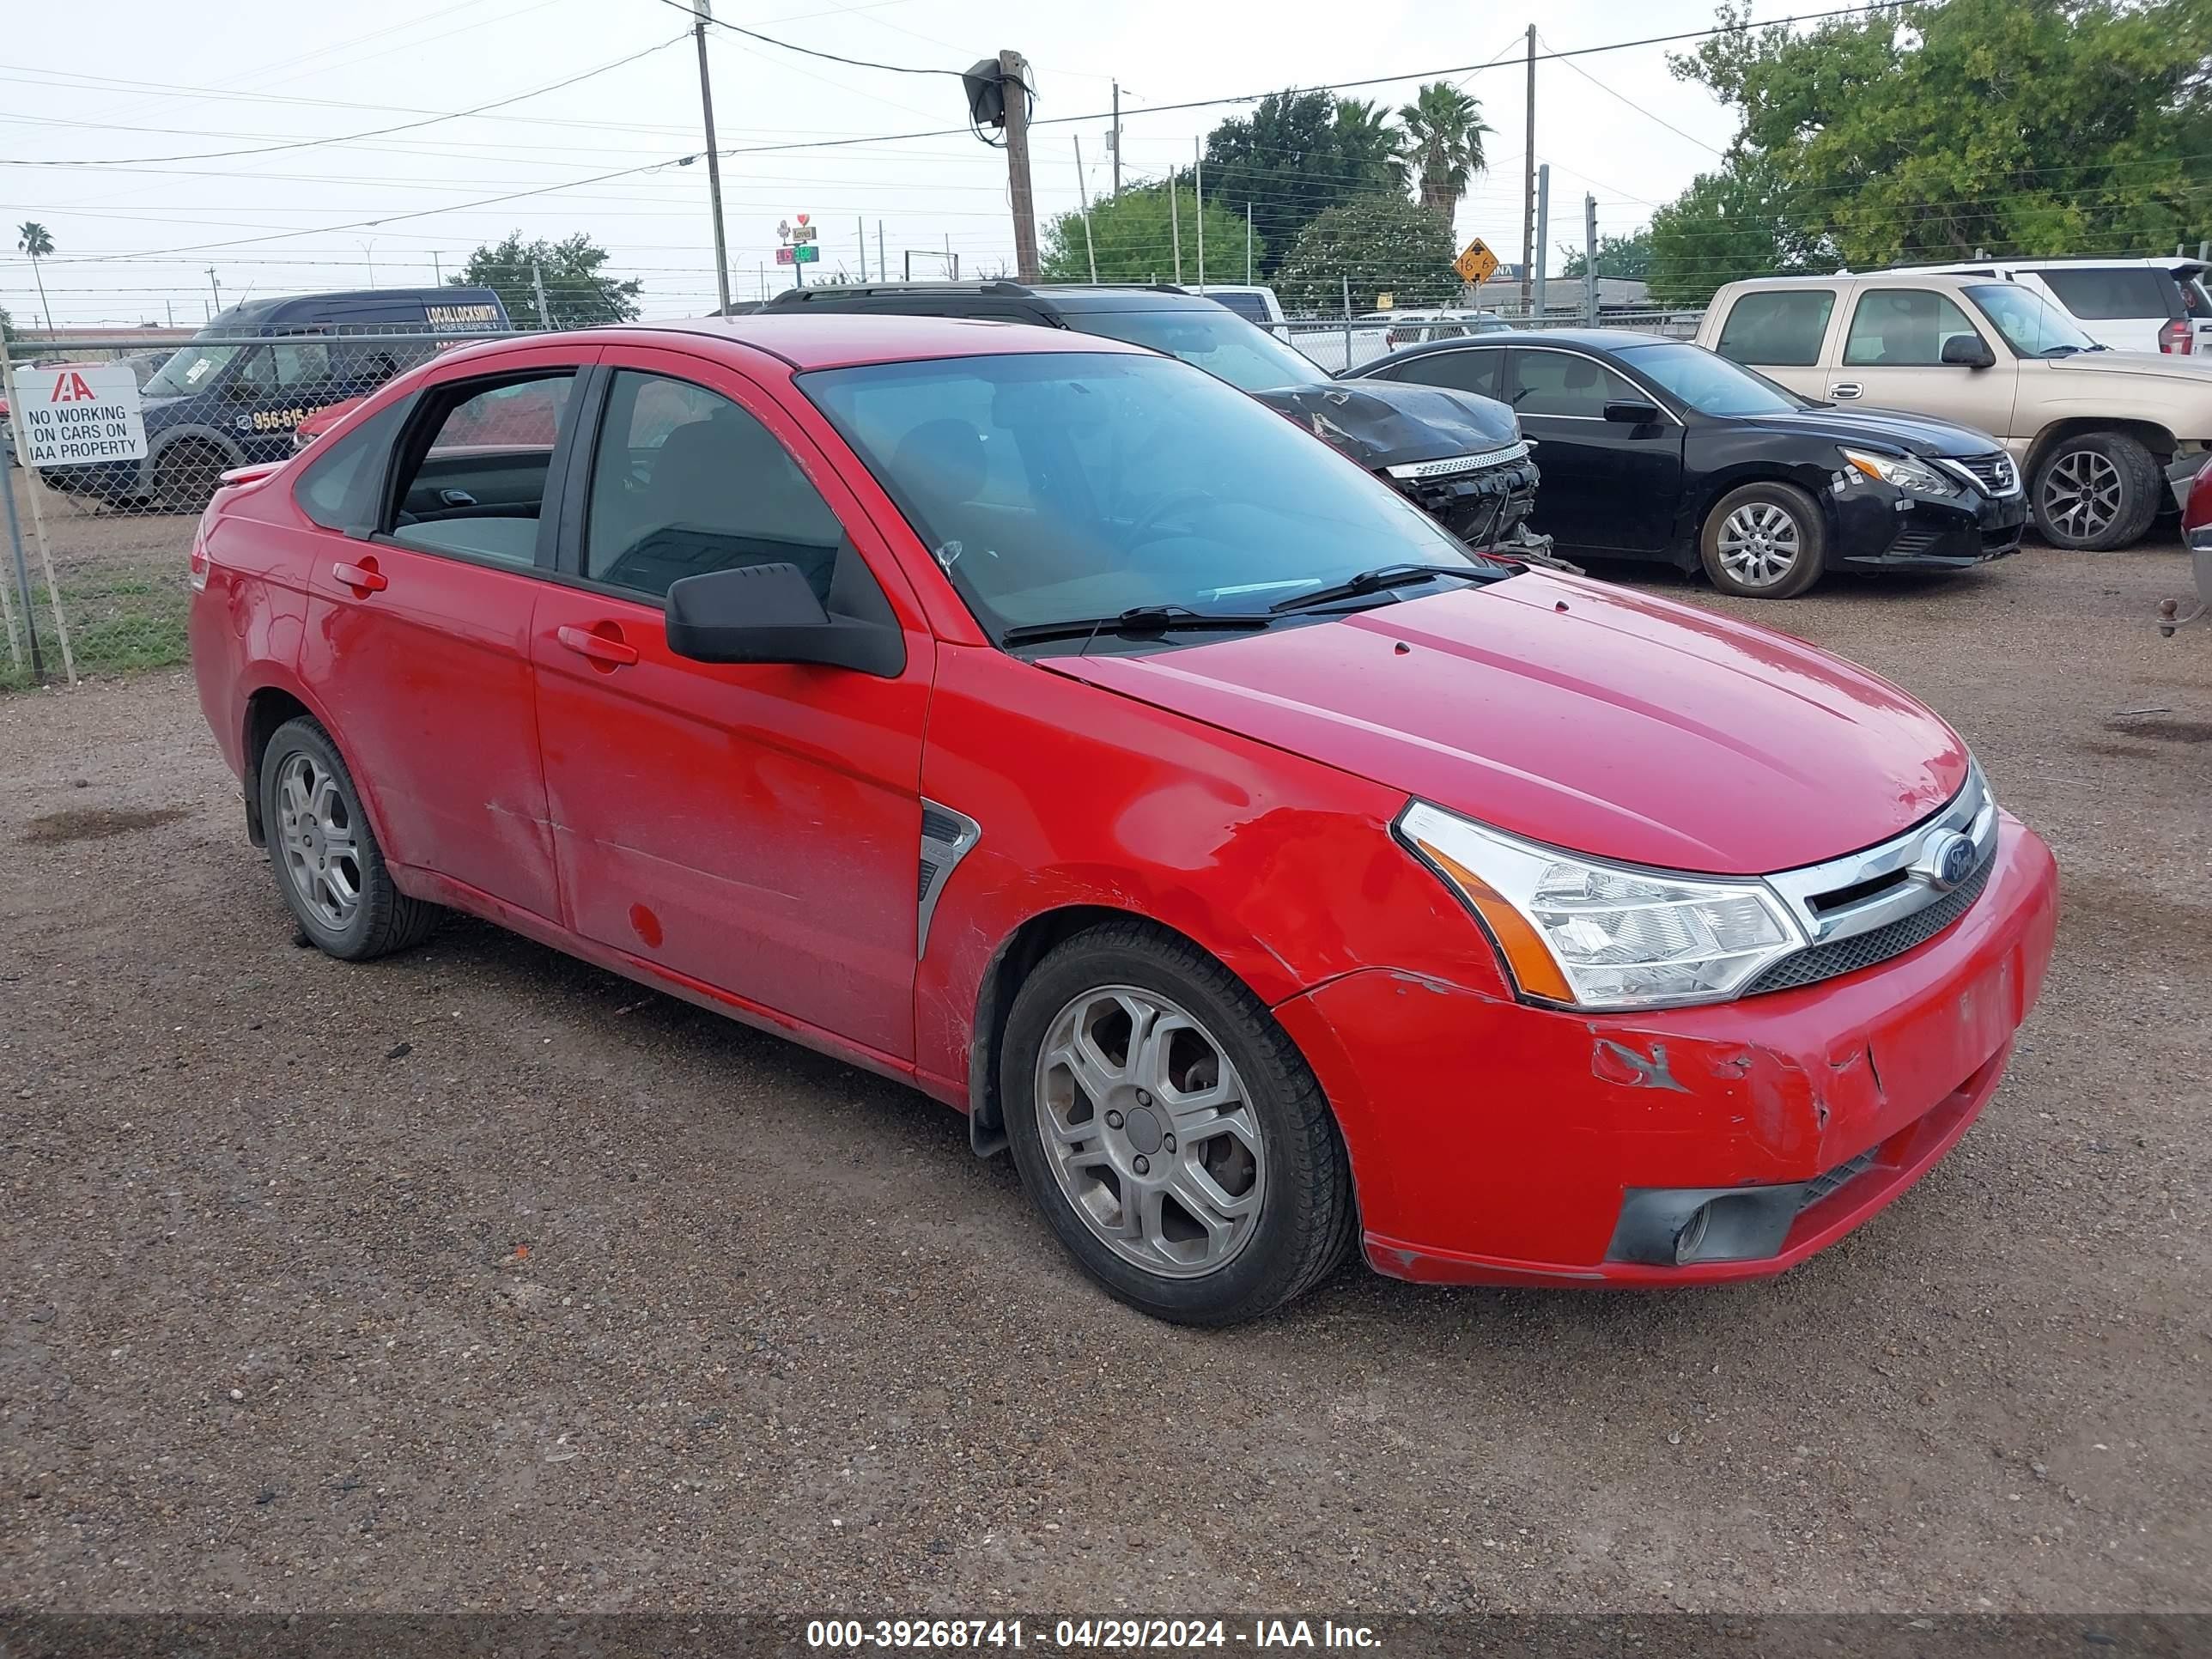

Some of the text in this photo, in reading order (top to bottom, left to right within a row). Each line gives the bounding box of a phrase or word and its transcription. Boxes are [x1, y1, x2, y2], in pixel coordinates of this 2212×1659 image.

[1460, 258, 1474, 271] 16
[28, 405, 127, 426] NO WORKING
[34, 423, 127, 443] ON CARS ON
[29, 439, 137, 461] IAA PROPERTY
[1951, 845, 1972, 880] Ford
